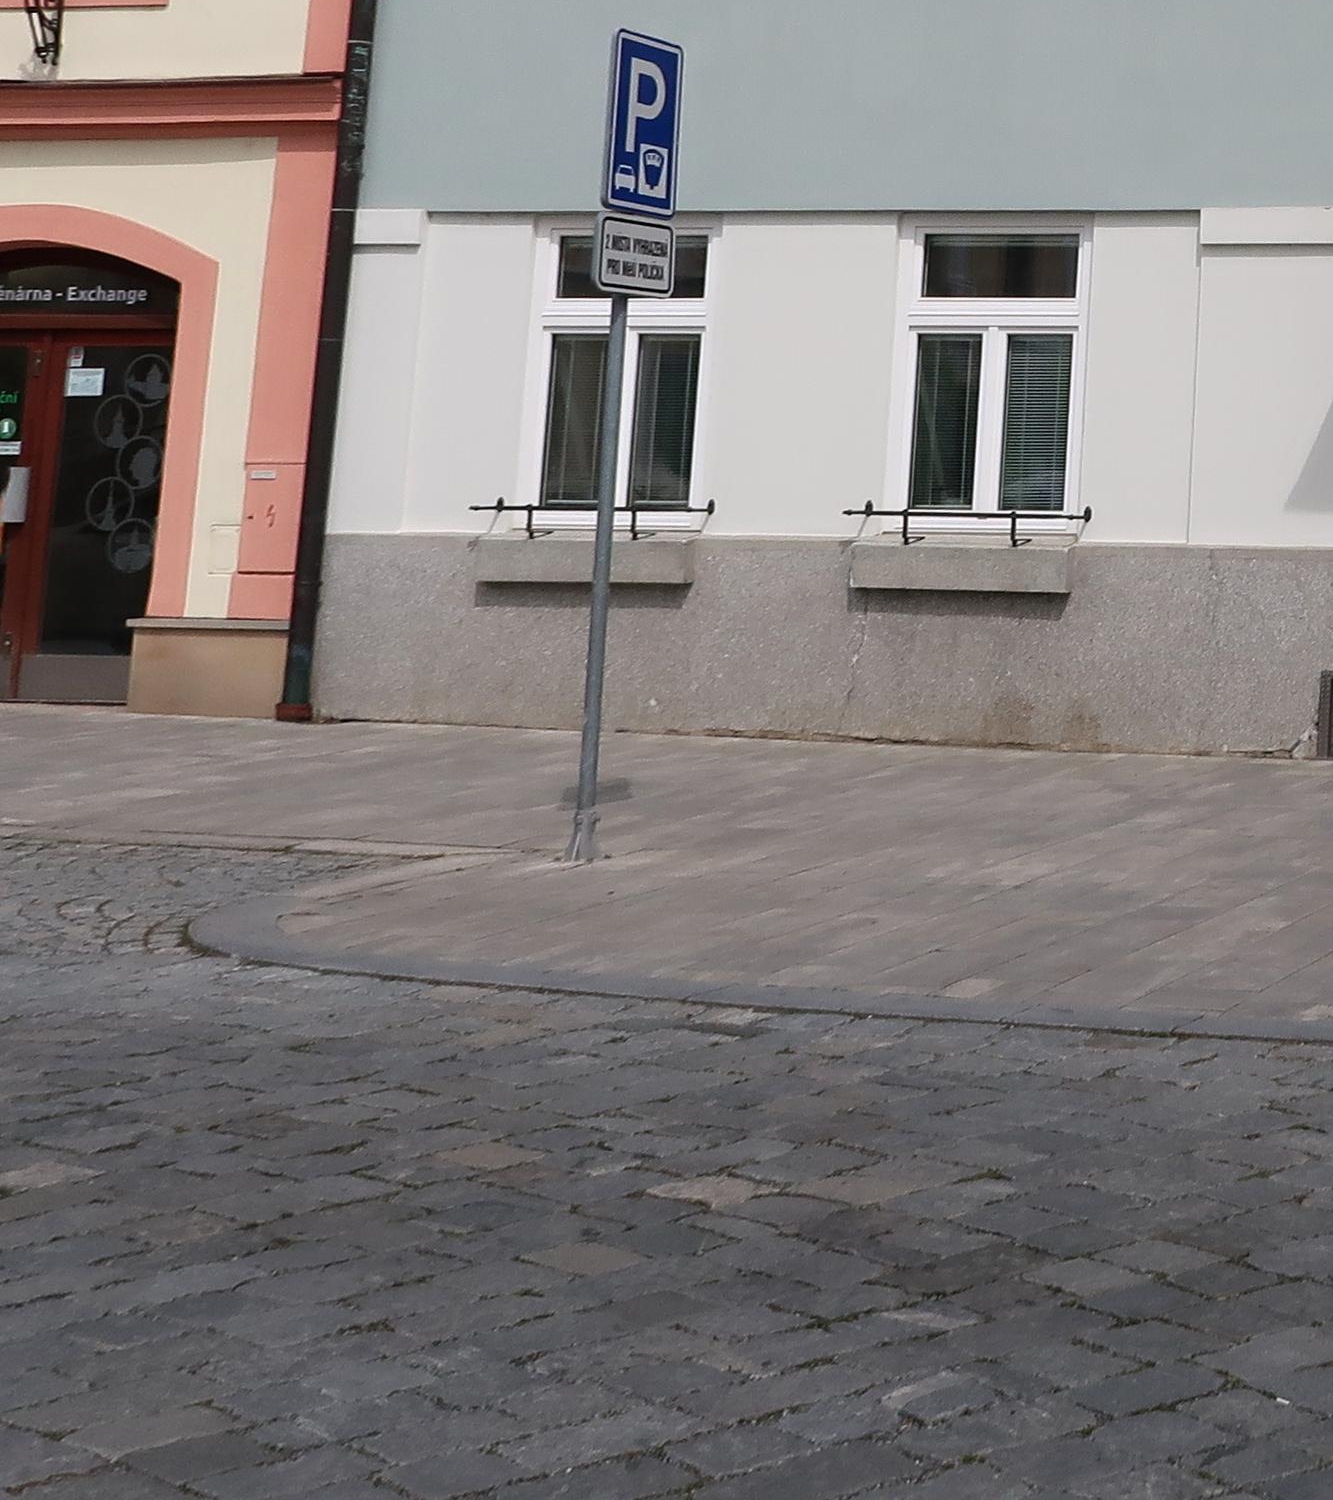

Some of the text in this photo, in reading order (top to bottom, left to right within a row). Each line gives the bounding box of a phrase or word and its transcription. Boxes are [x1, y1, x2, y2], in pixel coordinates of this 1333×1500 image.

[625, 56, 666, 153] P
[605, 233, 611, 249] 2
[606, 258, 621, 275] PRO
[66, 285, 148, 305] Exchange
